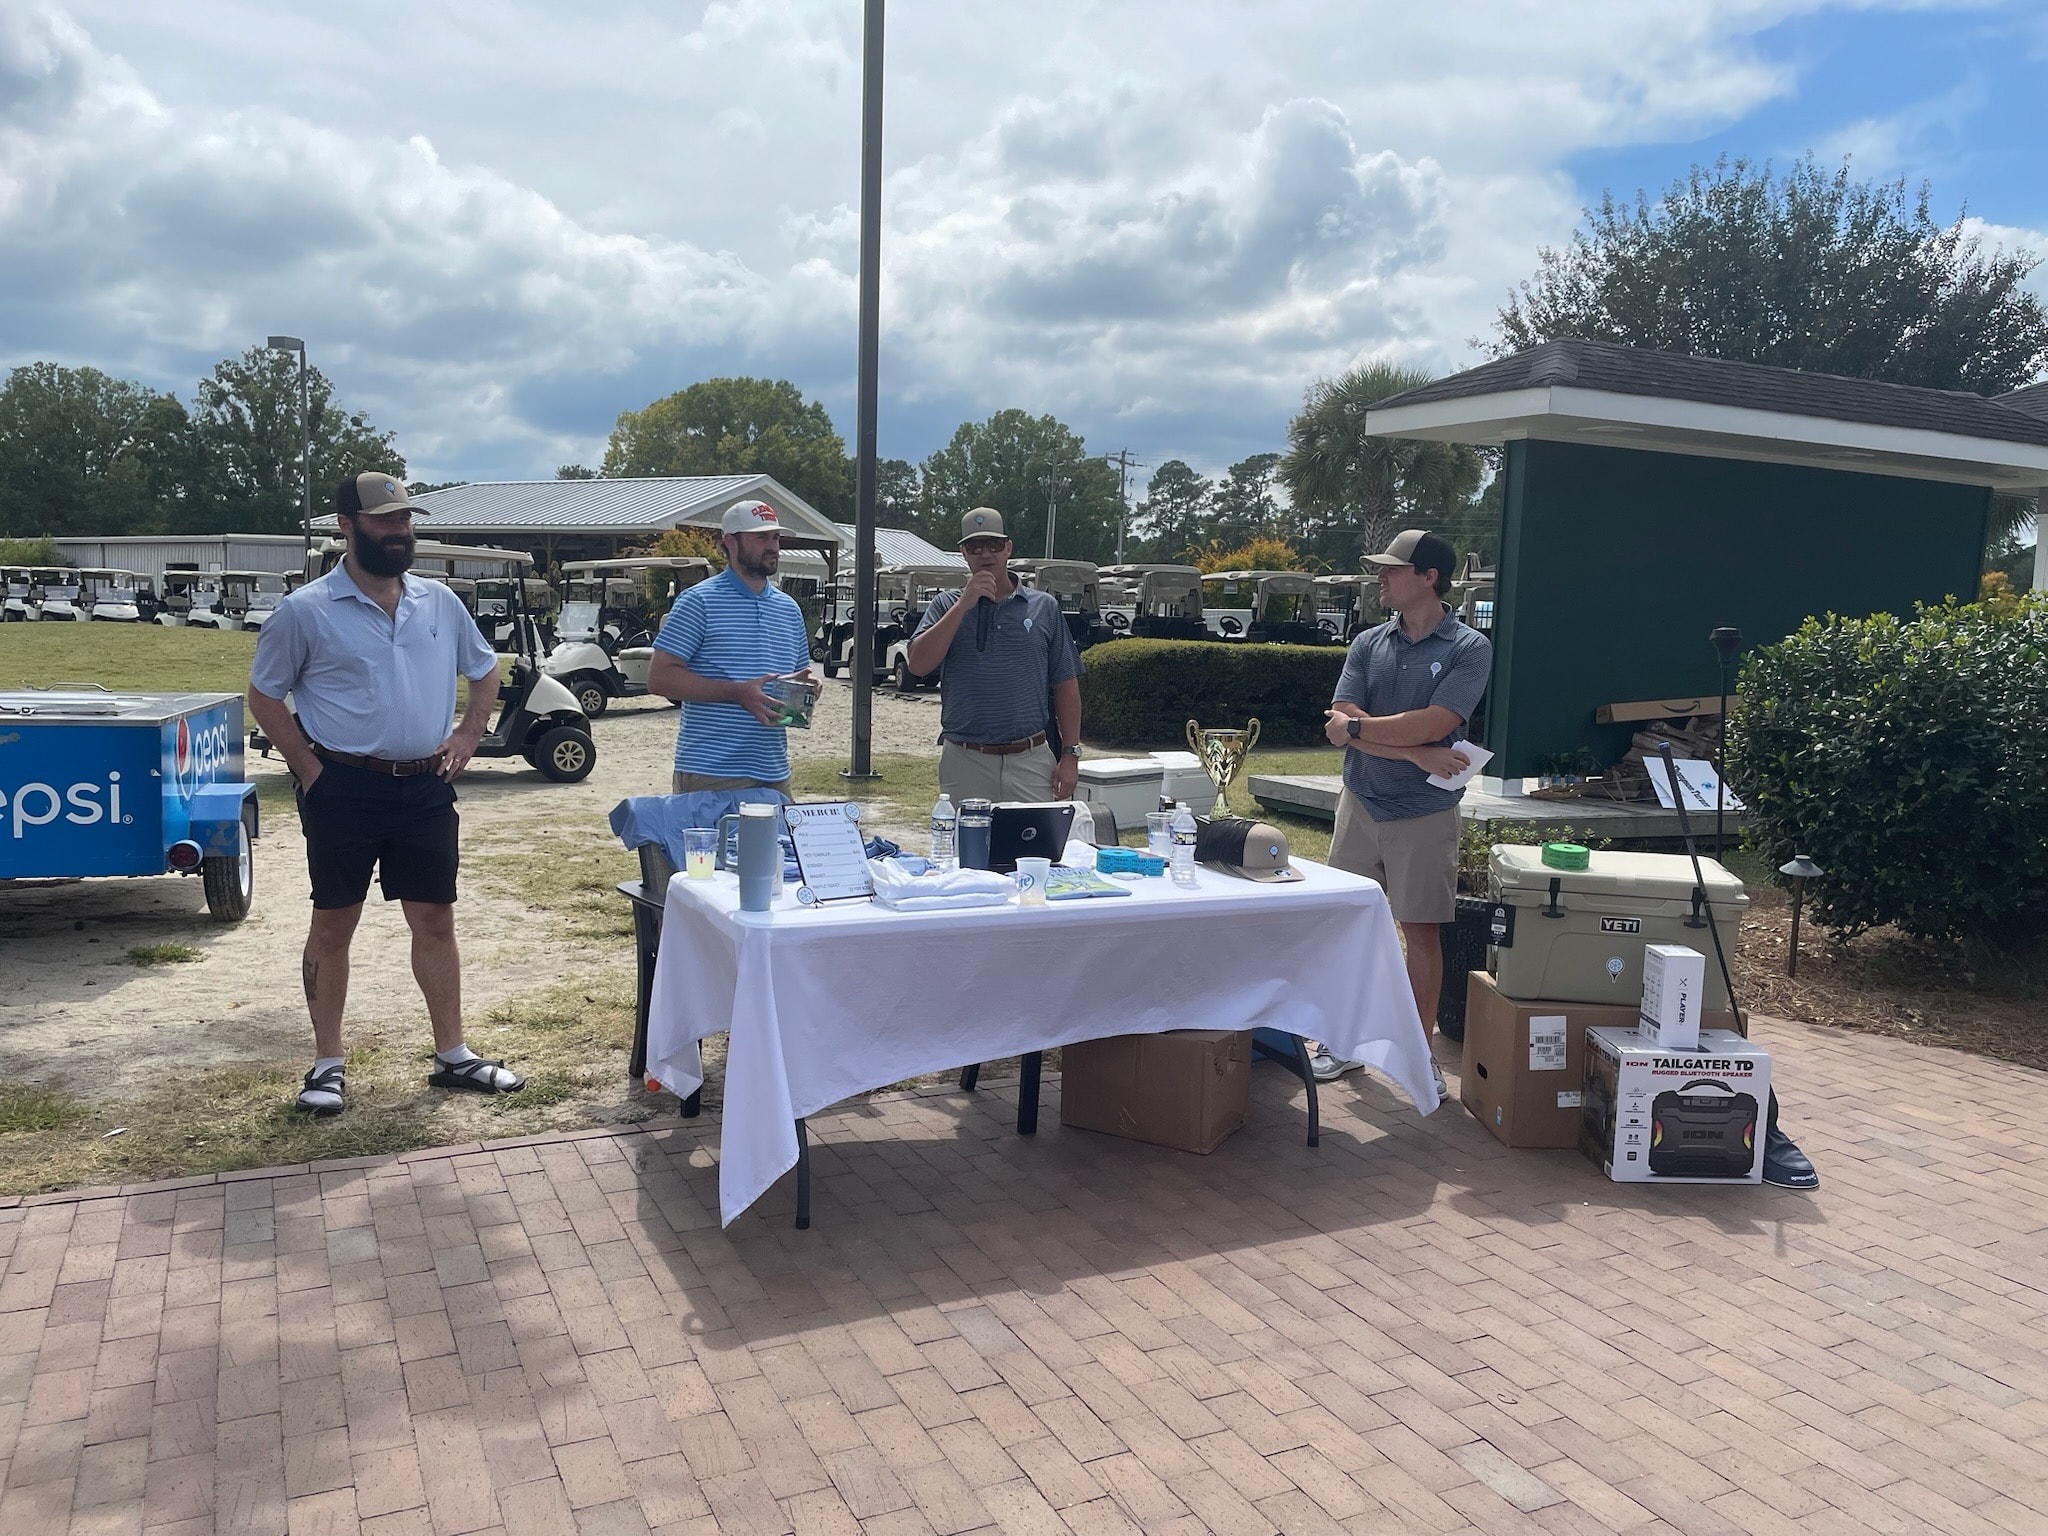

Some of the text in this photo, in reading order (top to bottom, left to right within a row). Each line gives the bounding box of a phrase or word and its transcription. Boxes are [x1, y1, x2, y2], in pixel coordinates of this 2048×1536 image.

[195, 711, 229, 790] pepsi
[0, 771, 121, 838] psi
[802, 808, 840, 817] MERCH!
[1602, 919, 1638, 931] YETI
[1679, 992, 1687, 1025] PLAYER
[1652, 1058, 1731, 1070] TAILGATER
[1734, 1060, 1754, 1071] TD
[1683, 1130, 1724, 1139] ION
